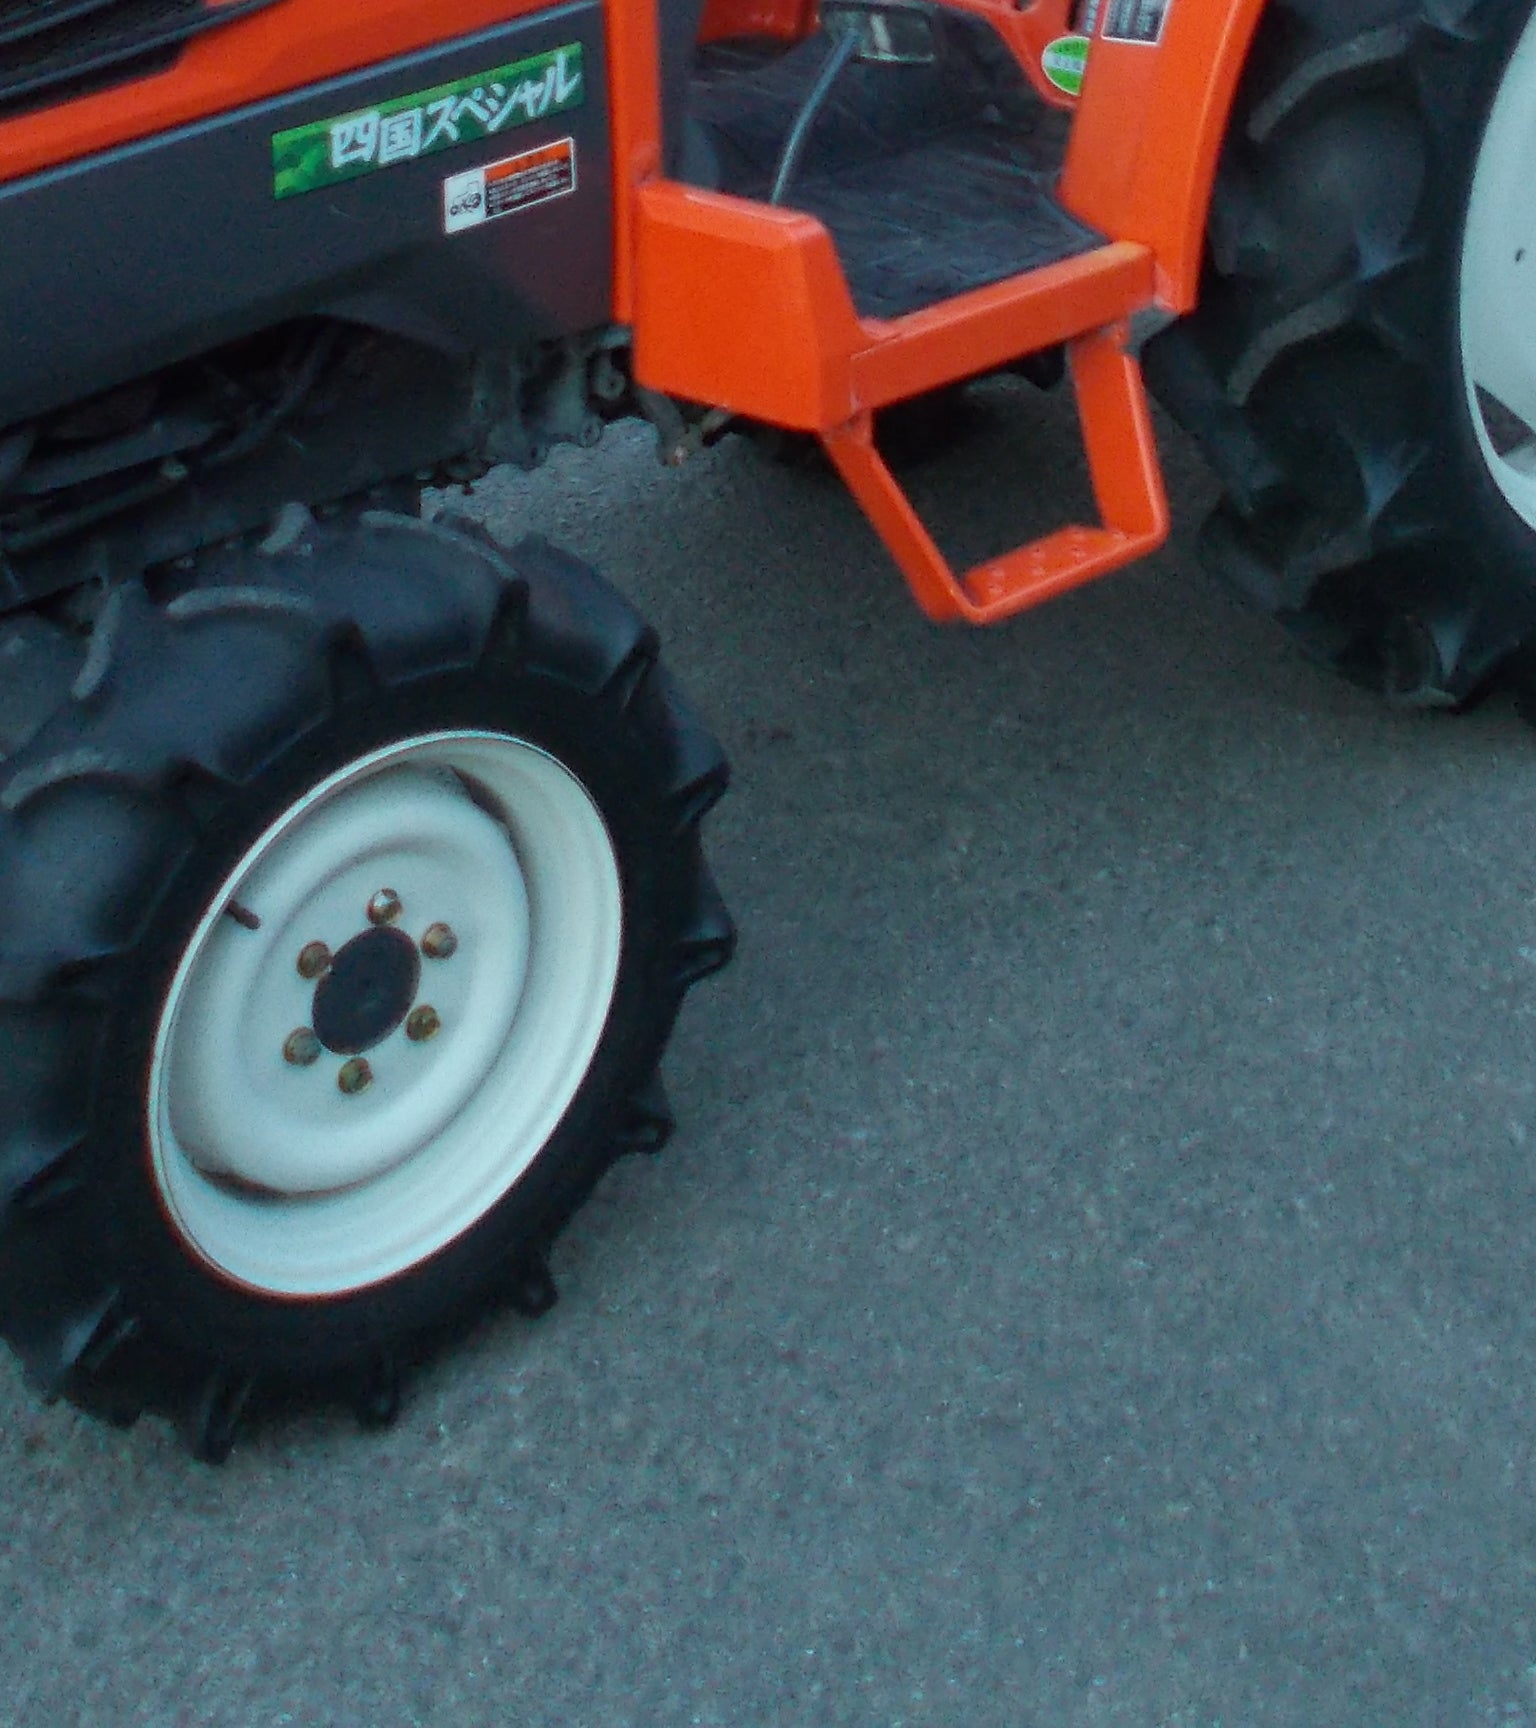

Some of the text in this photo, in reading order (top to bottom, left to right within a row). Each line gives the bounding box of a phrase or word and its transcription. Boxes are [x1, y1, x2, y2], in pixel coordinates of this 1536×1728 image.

[329, 50, 582, 168] 四国スペシャル
